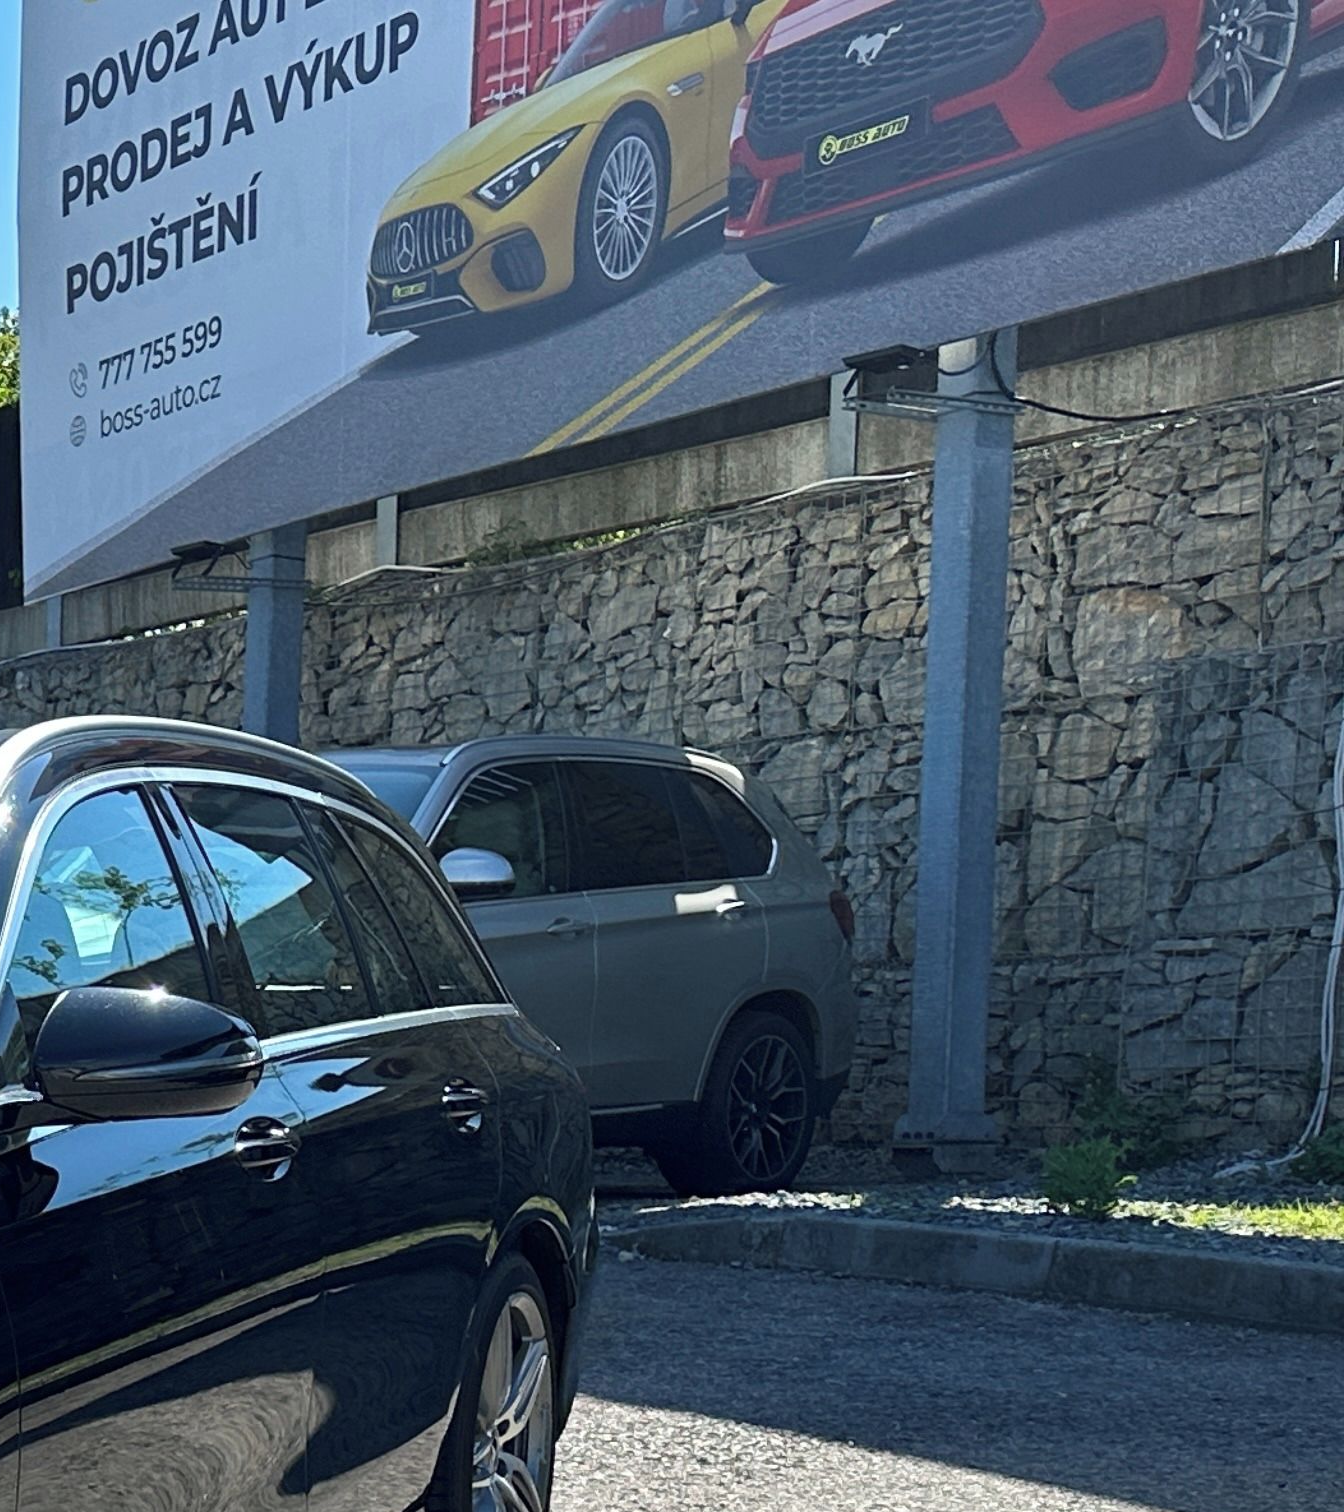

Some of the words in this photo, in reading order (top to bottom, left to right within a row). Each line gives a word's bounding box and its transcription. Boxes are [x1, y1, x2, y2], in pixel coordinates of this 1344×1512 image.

[61, 104, 213, 217] PRODEJ
[222, 88, 255, 146] A
[264, 10, 420, 123] VÝKUP
[64, 13, 200, 126] DOVOZ
[66, 171, 263, 314] POJIŠTĚNÍ
[98, 350, 134, 390] 777
[140, 332, 177, 374] 755
[181, 315, 223, 359] 599
[99, 374, 223, 438] boss-auto.cz
